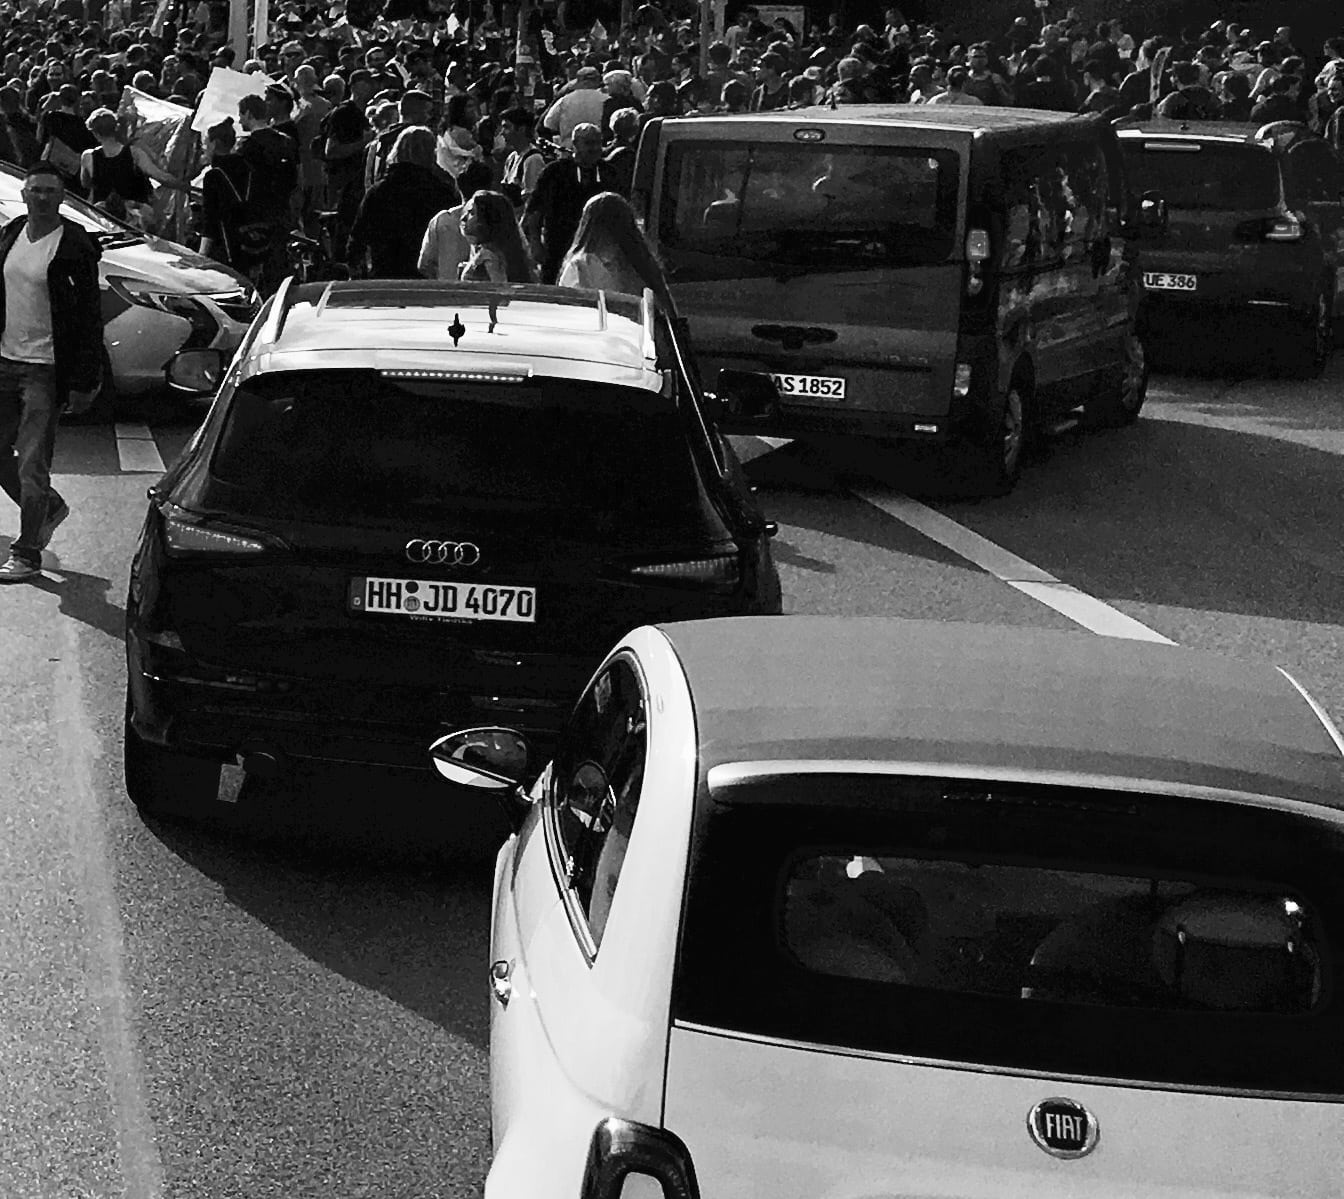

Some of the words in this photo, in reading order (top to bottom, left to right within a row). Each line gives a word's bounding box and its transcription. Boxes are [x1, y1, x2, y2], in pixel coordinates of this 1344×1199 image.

[1167, 275, 1195, 289] 386
[798, 376, 844, 396] 1852
[367, 581, 402, 610] HH
[423, 584, 458, 613] JD
[465, 586, 533, 618] 4070
[1045, 1112, 1083, 1141] FIAT
